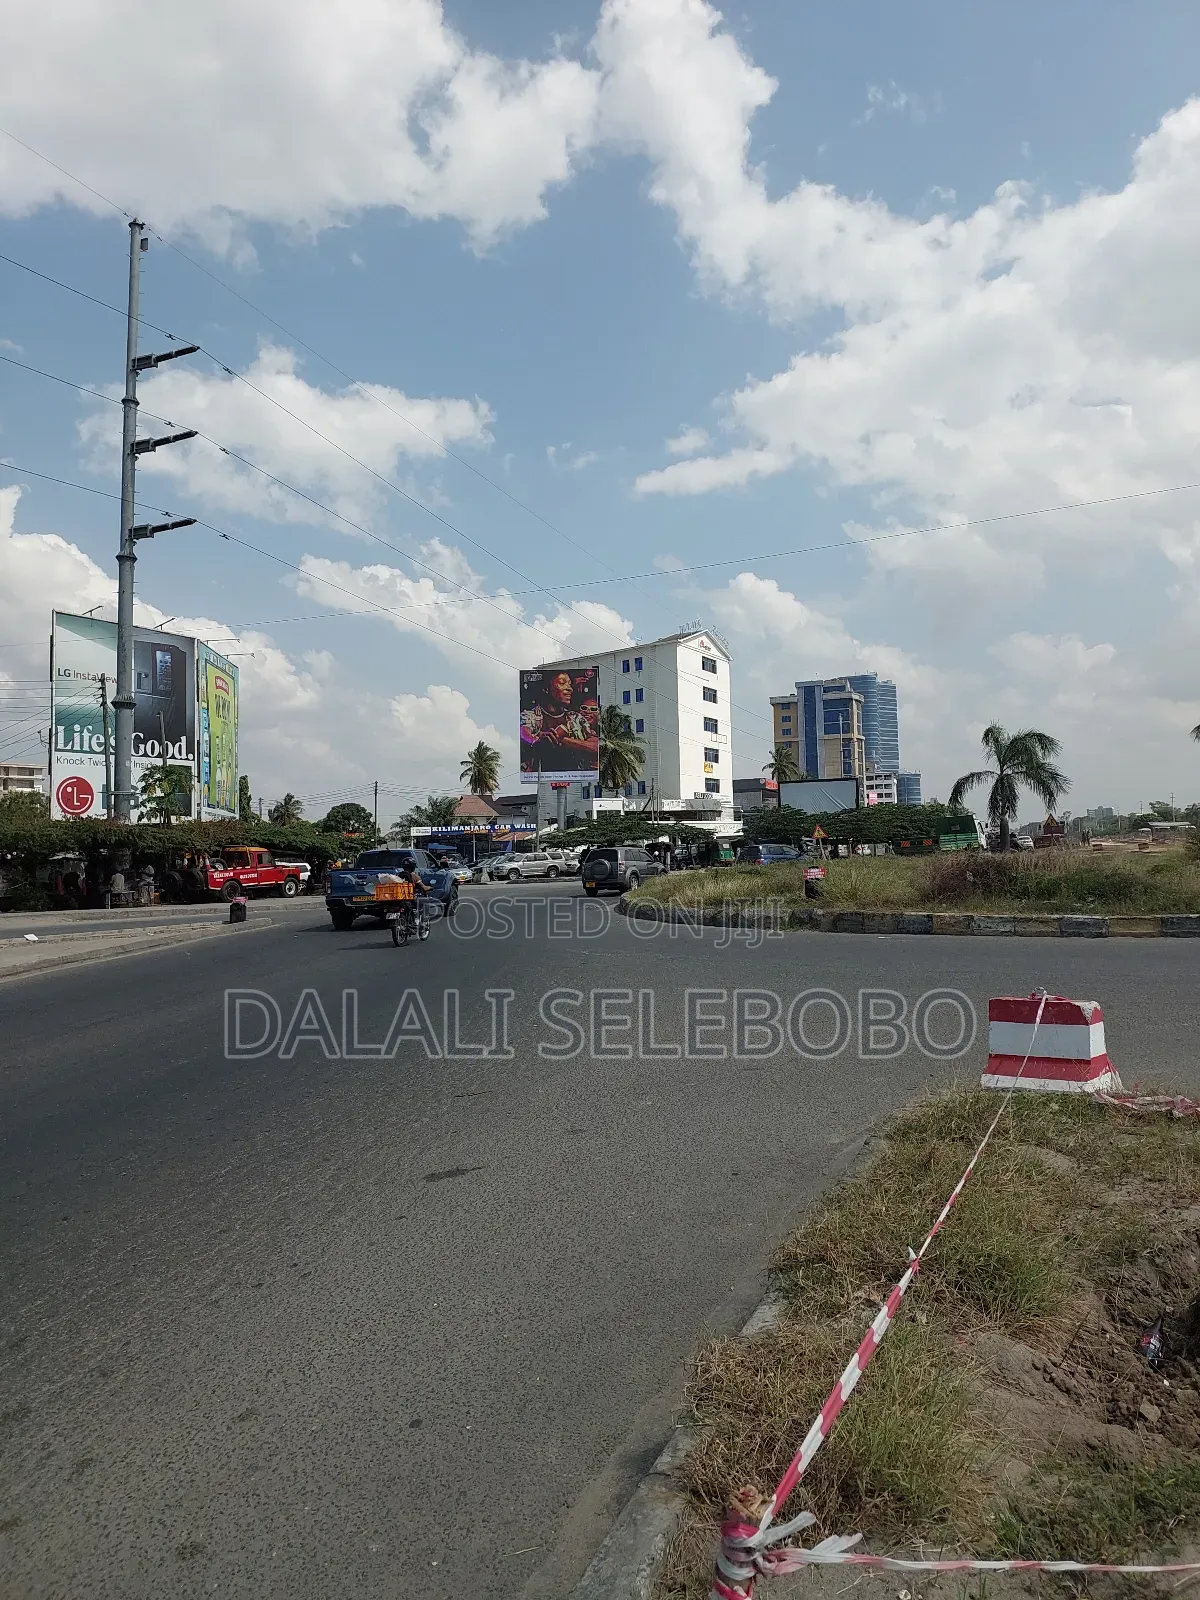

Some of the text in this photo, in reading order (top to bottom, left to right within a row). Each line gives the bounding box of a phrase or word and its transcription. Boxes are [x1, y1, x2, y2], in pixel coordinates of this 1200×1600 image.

[57, 667, 118, 684] LG InstaVew
[131, 732, 194, 761] Good.
[56, 755, 86, 766] Knock
[87, 757, 114, 768] Twic,
[431, 824, 491, 832] KILIMANJARO
